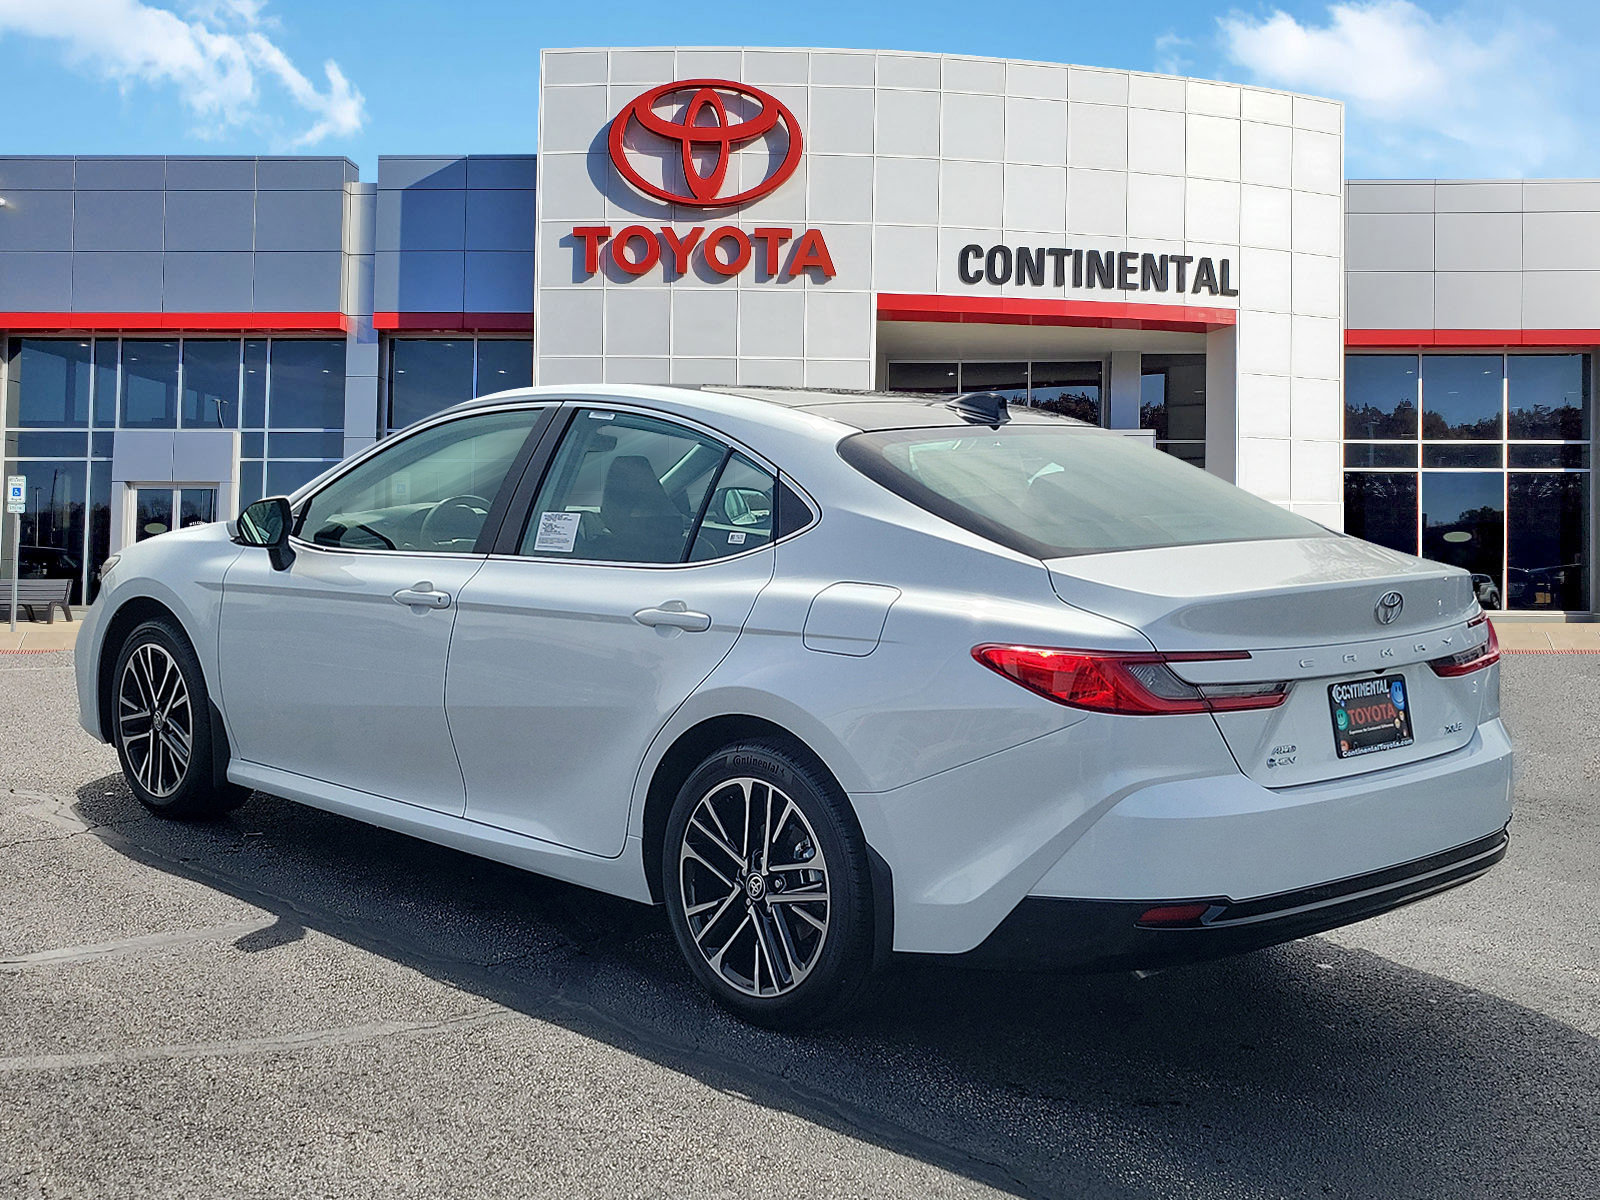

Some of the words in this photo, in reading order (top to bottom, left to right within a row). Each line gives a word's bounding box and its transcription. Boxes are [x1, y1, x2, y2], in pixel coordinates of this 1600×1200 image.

[573, 226, 836, 276] TOYOTA
[959, 245, 1238, 296] CONTINENTAL
[1299, 637, 1452, 669] CAMRY
[1347, 702, 1397, 725] TOYOTA
[733, 755, 779, 774] Continental
